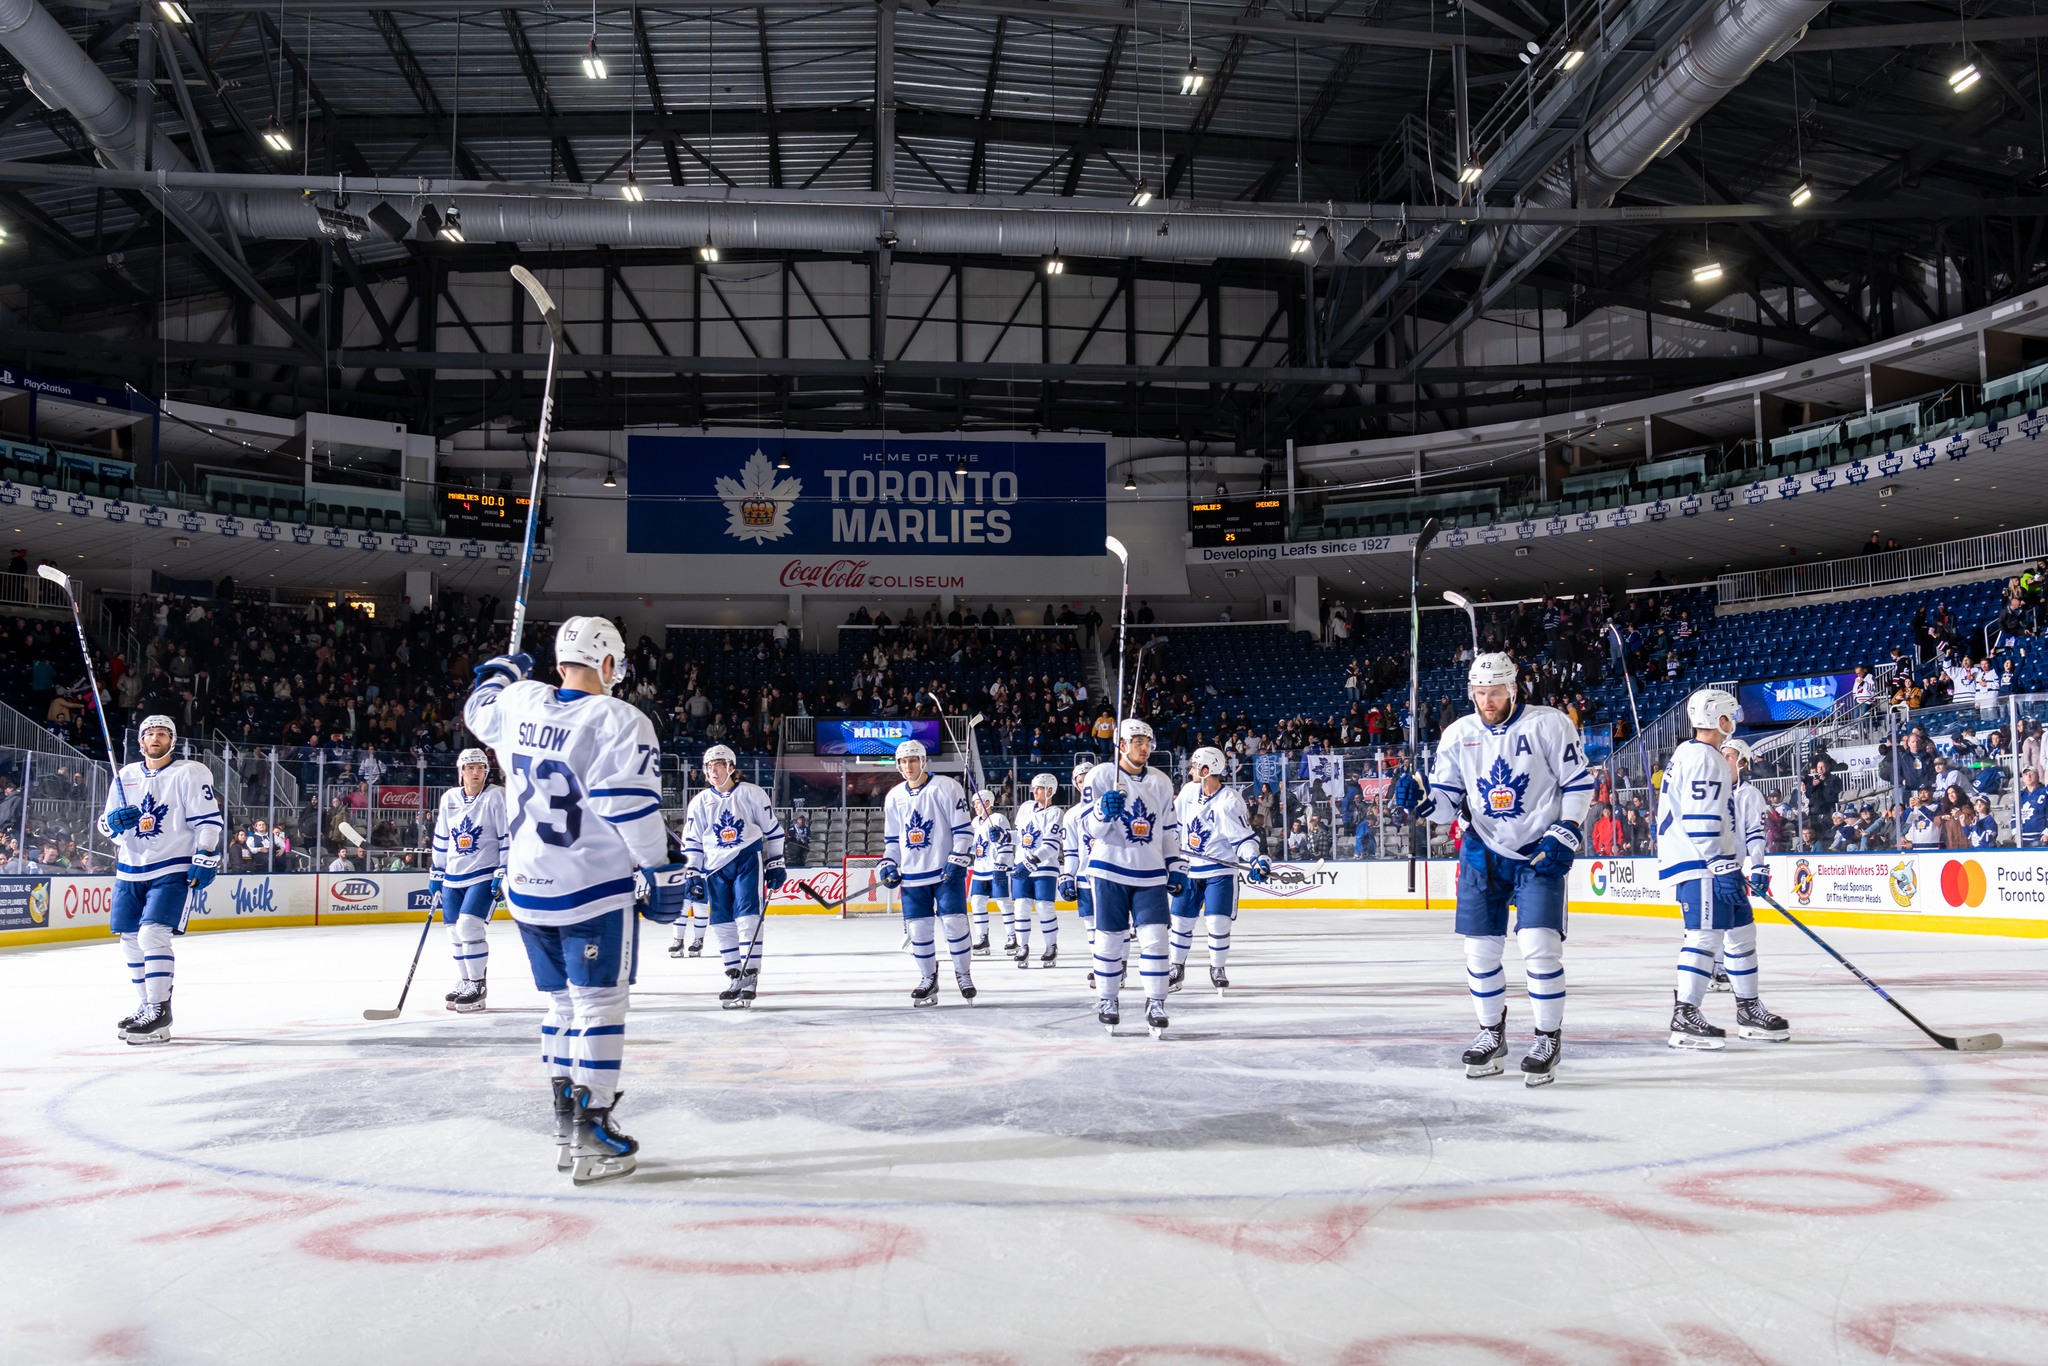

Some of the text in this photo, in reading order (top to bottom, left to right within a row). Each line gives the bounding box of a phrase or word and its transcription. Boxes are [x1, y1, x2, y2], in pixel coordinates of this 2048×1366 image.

[24, 378, 71, 395] PlayStation
[2020, 415, 2047, 431] PALMATEER
[1980, 428, 2008, 444] FERGUSON
[1947, 440, 1968, 452] ACOMB
[863, 453, 979, 462] HOME OF THE
[1915, 448, 1934, 460] EVANS
[1880, 456, 1902, 469] GLENNIE
[1847, 465, 1866, 477] PELYK
[1812, 473, 1835, 484] MEEHAN
[824, 470, 1018, 505] TORONTO
[1780, 480, 1800, 491] BYERS
[32, 493, 56, 504] HARRIS
[448, 493, 479, 501] MARLIES
[481, 495, 505, 507] 00.0
[1712, 494, 1732, 504] SMITH
[106, 505, 127, 516] HURST
[463, 502, 471, 511] 4
[1681, 500, 1700, 510] SMITH
[1578, 516, 1597, 525] BOYER
[1609, 511, 1636, 521] CARLETON
[218, 520, 243, 530] PULFORD
[832, 508, 1012, 544] MARLIES
[1519, 526, 1533, 534] ELLIS
[1548, 522, 1565, 530] SELBY
[294, 529, 311, 537] BAUN
[325, 532, 348, 541] GIRARD
[1225, 533, 1235, 541] 25
[1448, 533, 1467, 542] PAPPIN
[360, 536, 380, 545] NEVIN
[393, 538, 417, 547] BREWER
[428, 542, 450, 550] REGAN
[461, 544, 486, 552] JARRETT
[496, 546, 518, 555] MARTIN
[532, 548, 550, 557] ROWN
[1203, 538, 1391, 561] Developing Leafs since 1927
[779, 559, 965, 589] Coca-Cola COLISEUM
[568, 631, 578, 641] 73
[1480, 662, 1492, 670] 43
[1775, 685, 1826, 702] MARLIES
[519, 722, 571, 752] SOLOW
[854, 727, 902, 738] MARLIES
[1515, 735, 1532, 756] A
[638, 744, 662, 778] 73
[1691, 780, 1723, 801] 57
[382, 791, 421, 806] Coca-Cola
[510, 752, 583, 848] 73
[2037, 795, 2045, 804] C
[1207, 810, 1215, 823] A
[1609, 861, 1635, 884] Pixel
[1818, 864, 1888, 876] Electrical Workers 353
[1998, 867, 2032, 881] Proud
[340, 883, 371, 896] AHL
[1834, 882, 1873, 893] Proud Sponsors
[1610, 887, 1660, 901] The Google Phone
[1826, 893, 1881, 904] Of The Hammer Heads
[1998, 887, 2045, 903] Toronto
